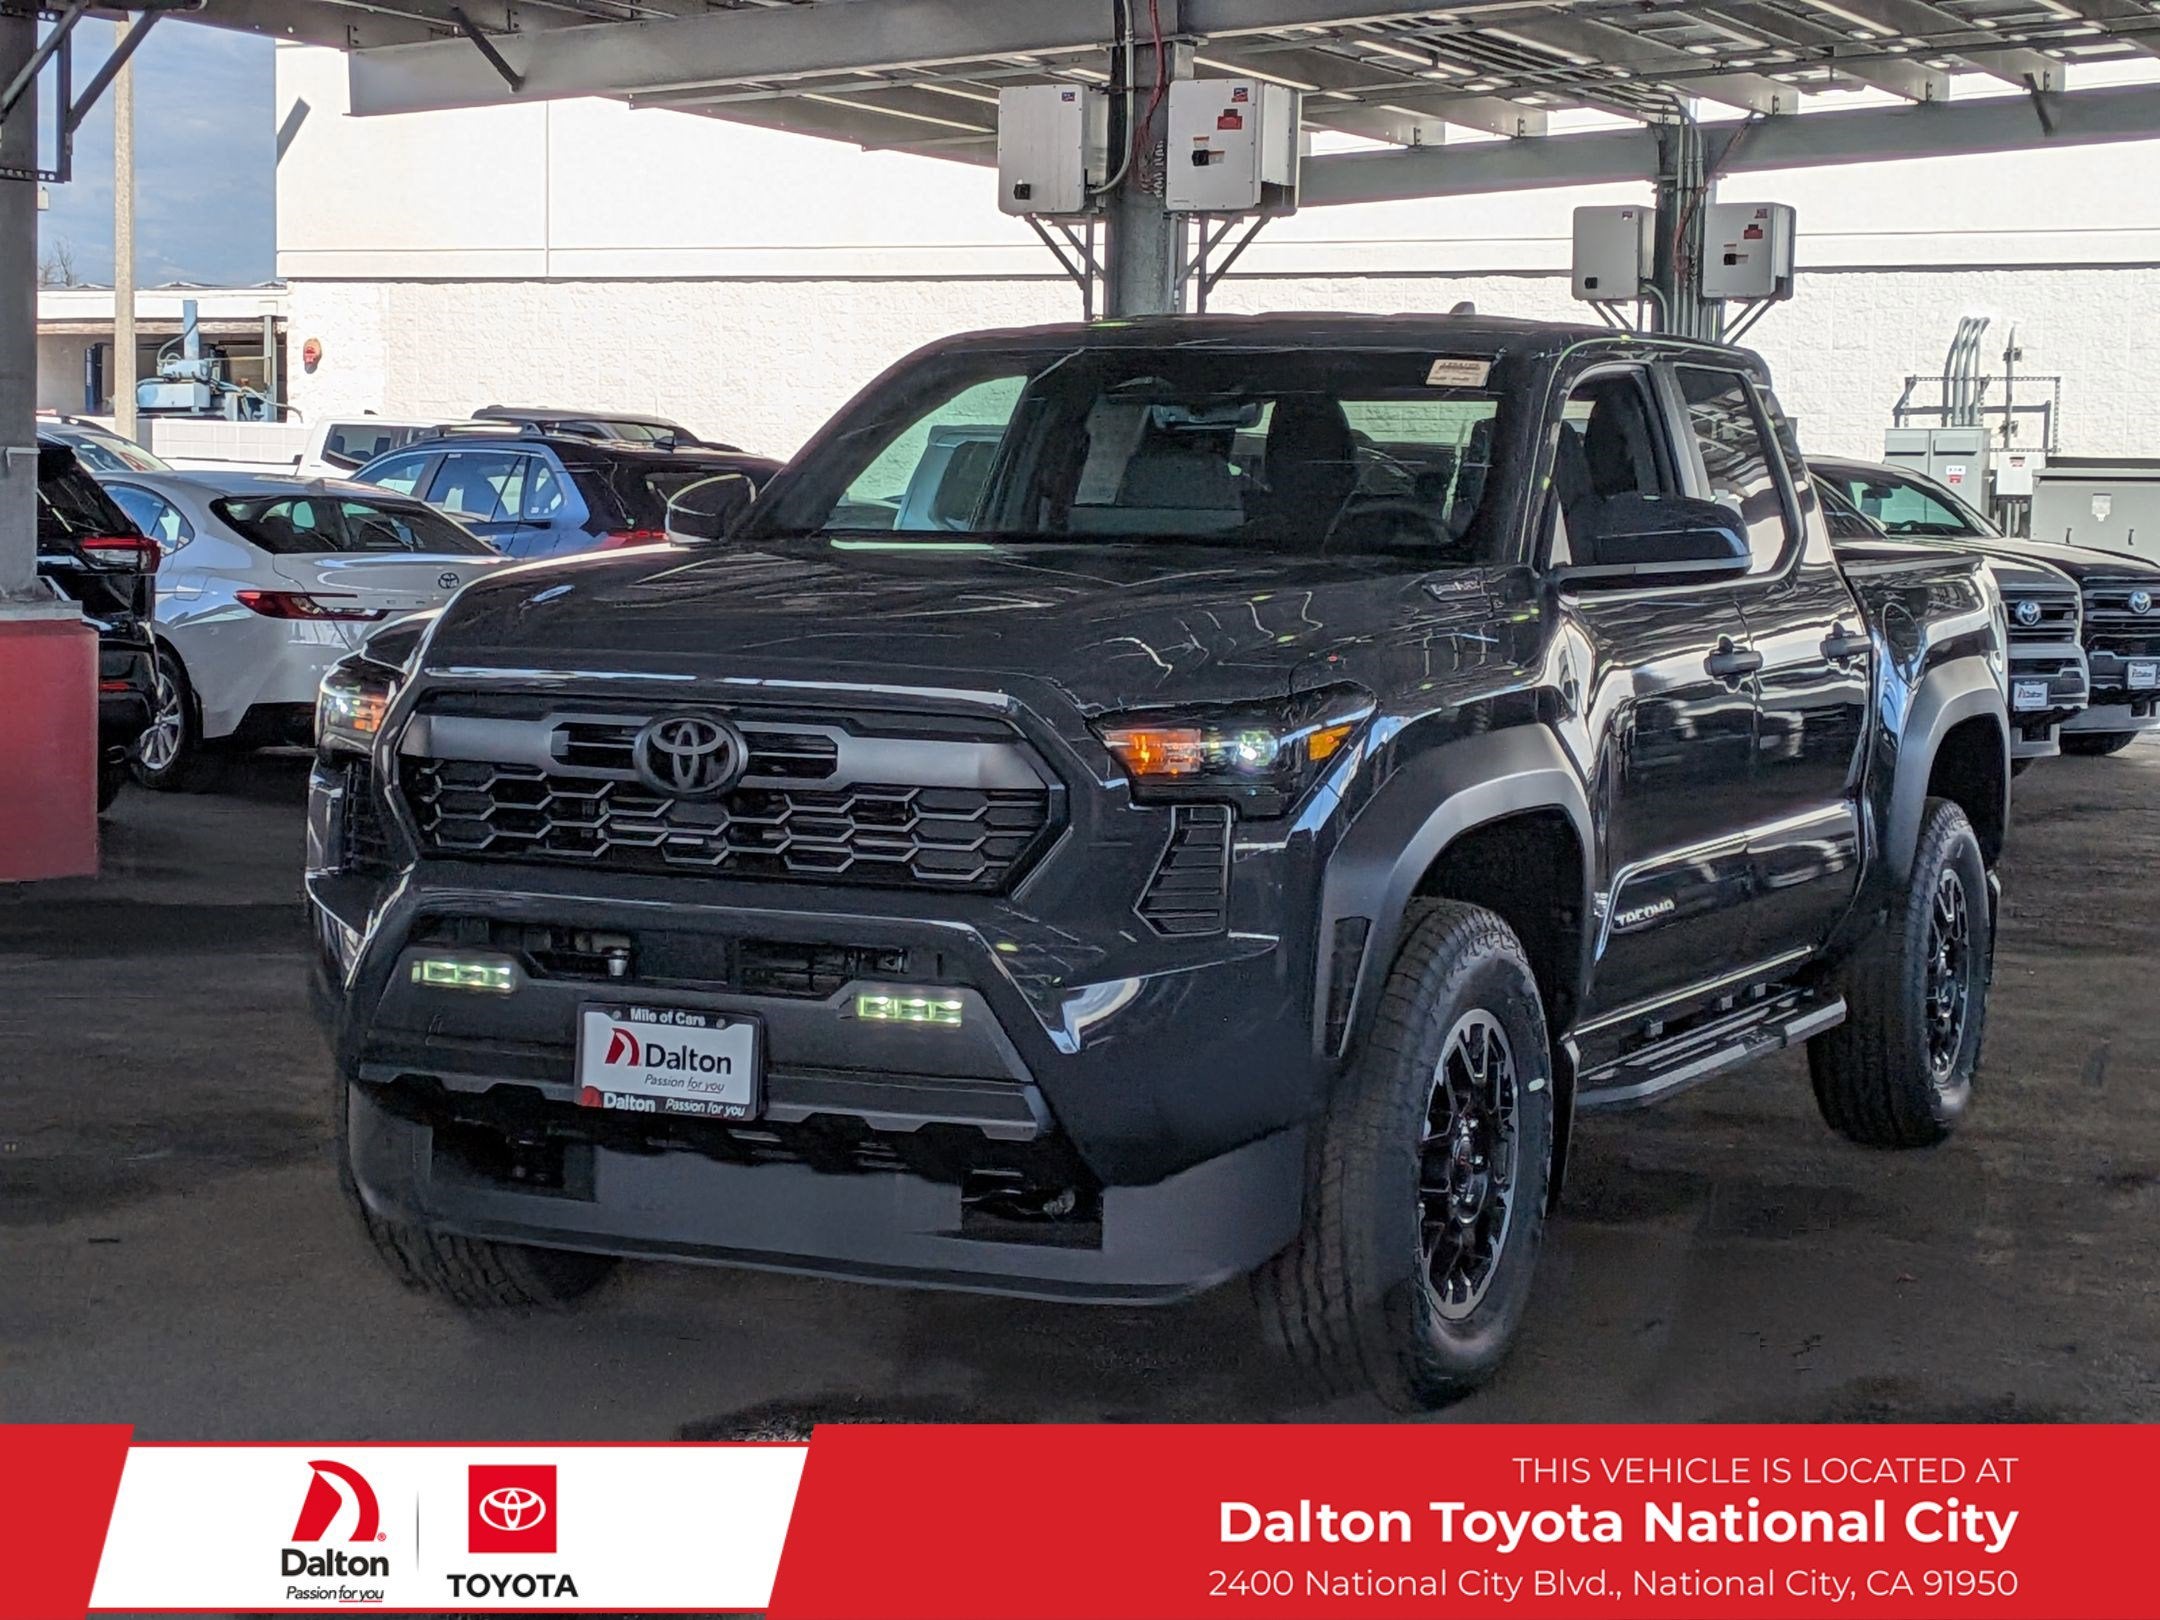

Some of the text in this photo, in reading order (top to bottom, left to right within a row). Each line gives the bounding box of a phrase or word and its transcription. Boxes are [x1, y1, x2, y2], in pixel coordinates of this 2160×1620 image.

[1614, 898, 1676, 927] TACOMA
[630, 1007, 706, 1027] Mile of Cars
[645, 1043, 732, 1075] Dalton
[644, 1073, 726, 1093] Passion for you
[603, 1092, 656, 1112] Dalton
[665, 1098, 746, 1117] Passion for you
